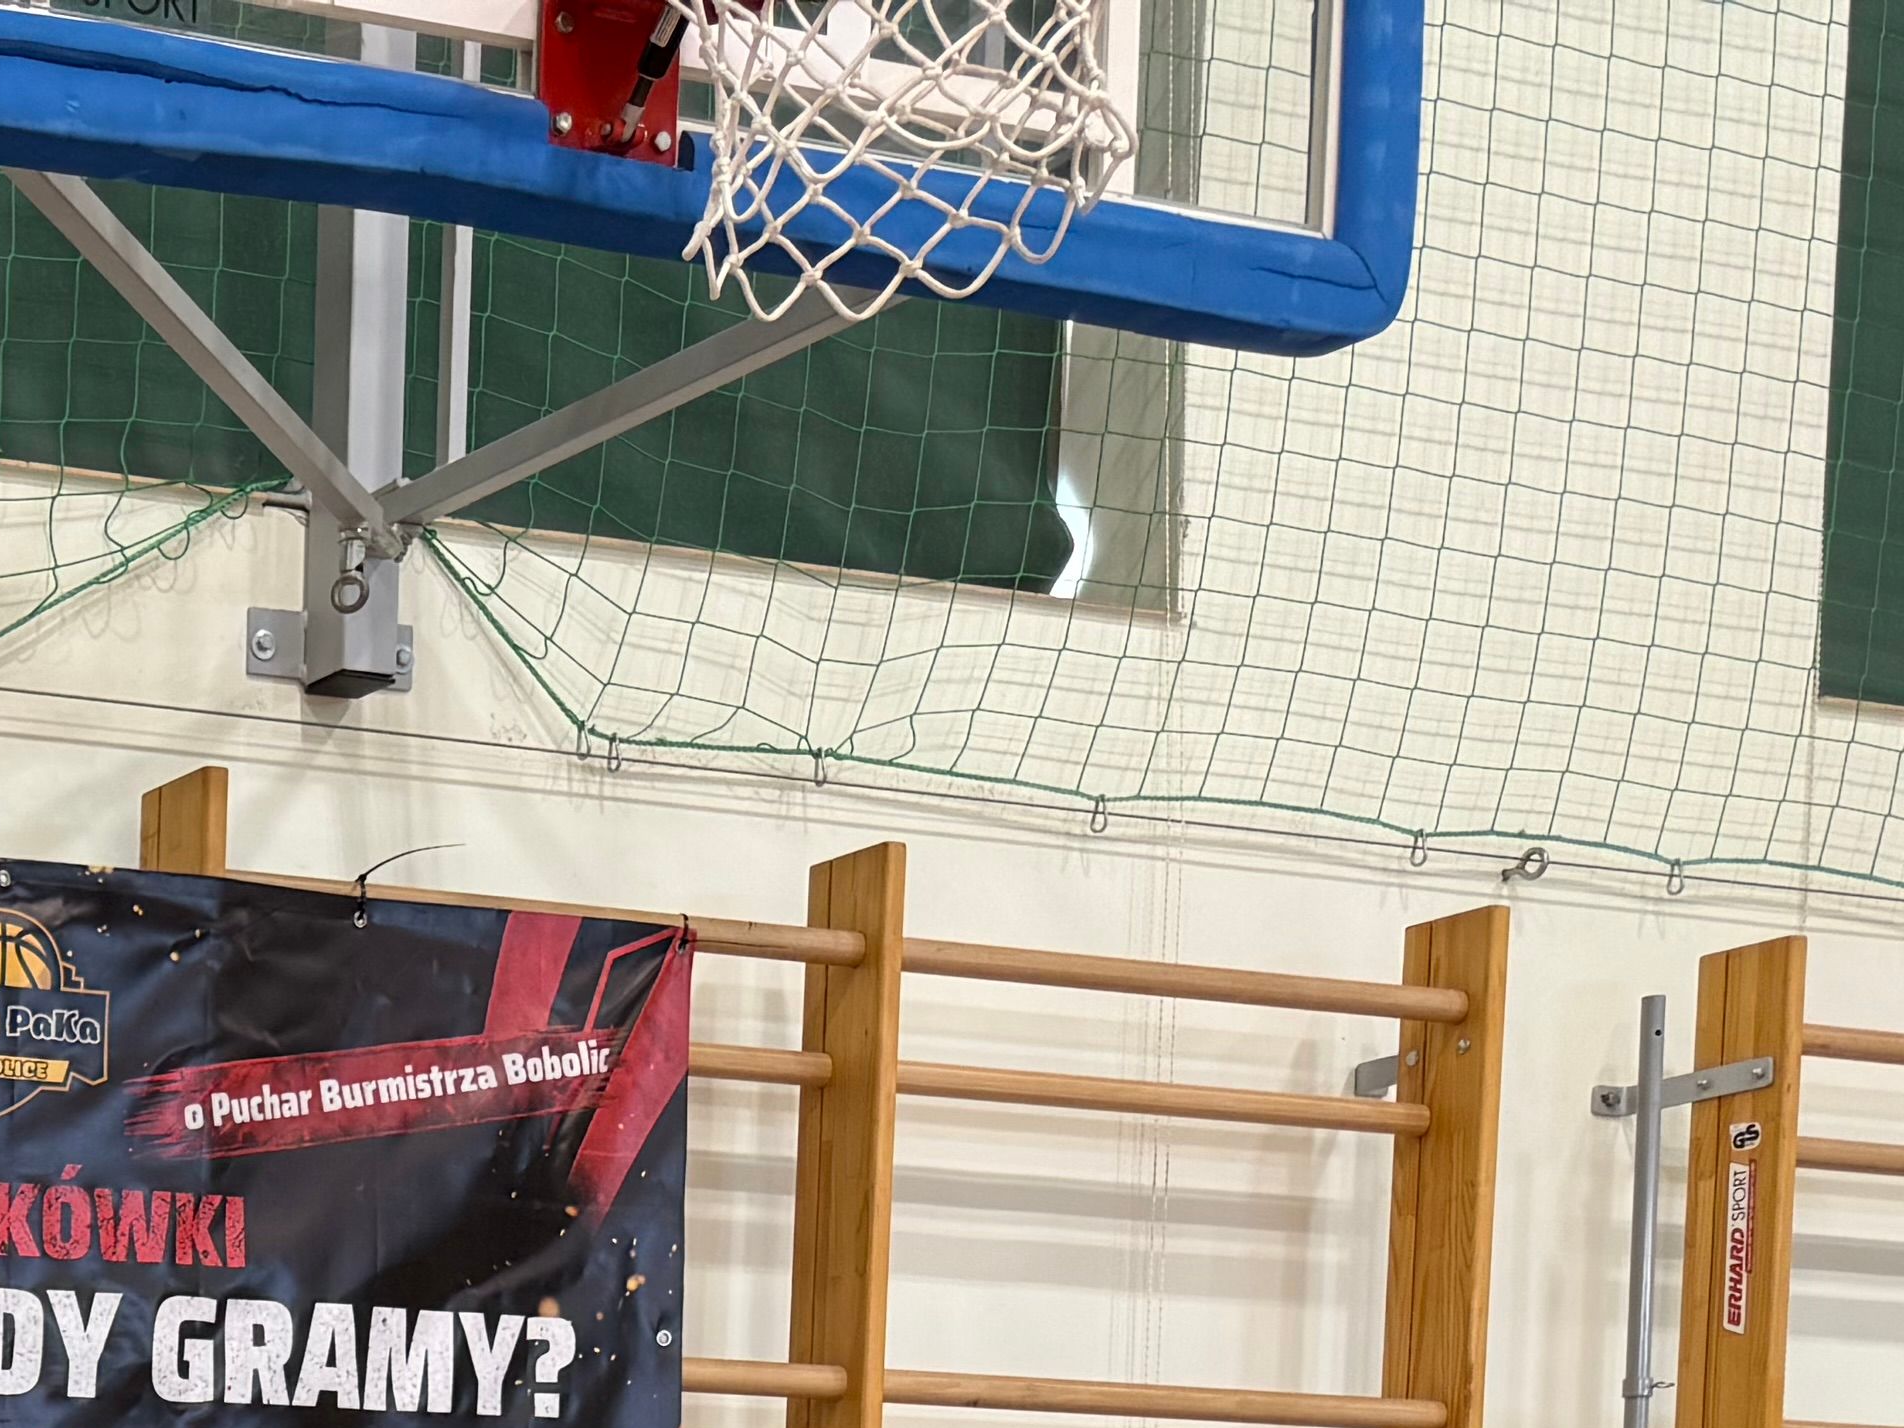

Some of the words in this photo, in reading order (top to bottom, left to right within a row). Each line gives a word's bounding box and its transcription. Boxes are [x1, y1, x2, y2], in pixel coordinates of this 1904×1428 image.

[183, 1103, 205, 1131] o
[210, 1084, 313, 1127] Puchar
[319, 1064, 498, 1113] Burmistrza
[1731, 1170, 1748, 1222] SPORT
[1727, 1227, 1745, 1327] ERHARD
[150, 1294, 578, 1421] GRAMY?
